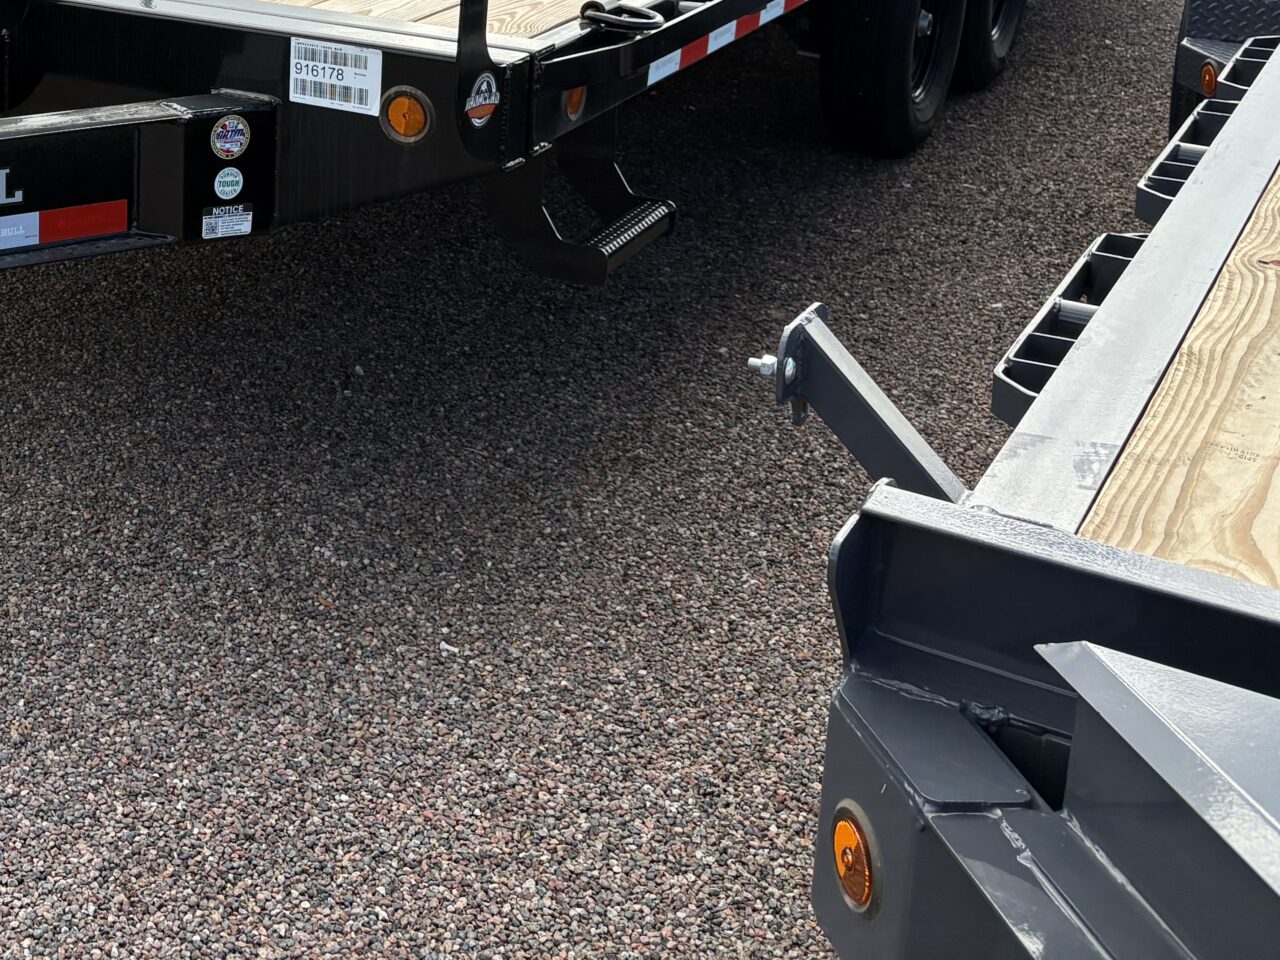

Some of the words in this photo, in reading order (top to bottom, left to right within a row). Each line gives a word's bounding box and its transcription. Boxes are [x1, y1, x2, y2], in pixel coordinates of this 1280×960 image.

[294, 61, 345, 82] 916178
[218, 180, 240, 188] TOUGH
[212, 204, 244, 216] NOTICE
